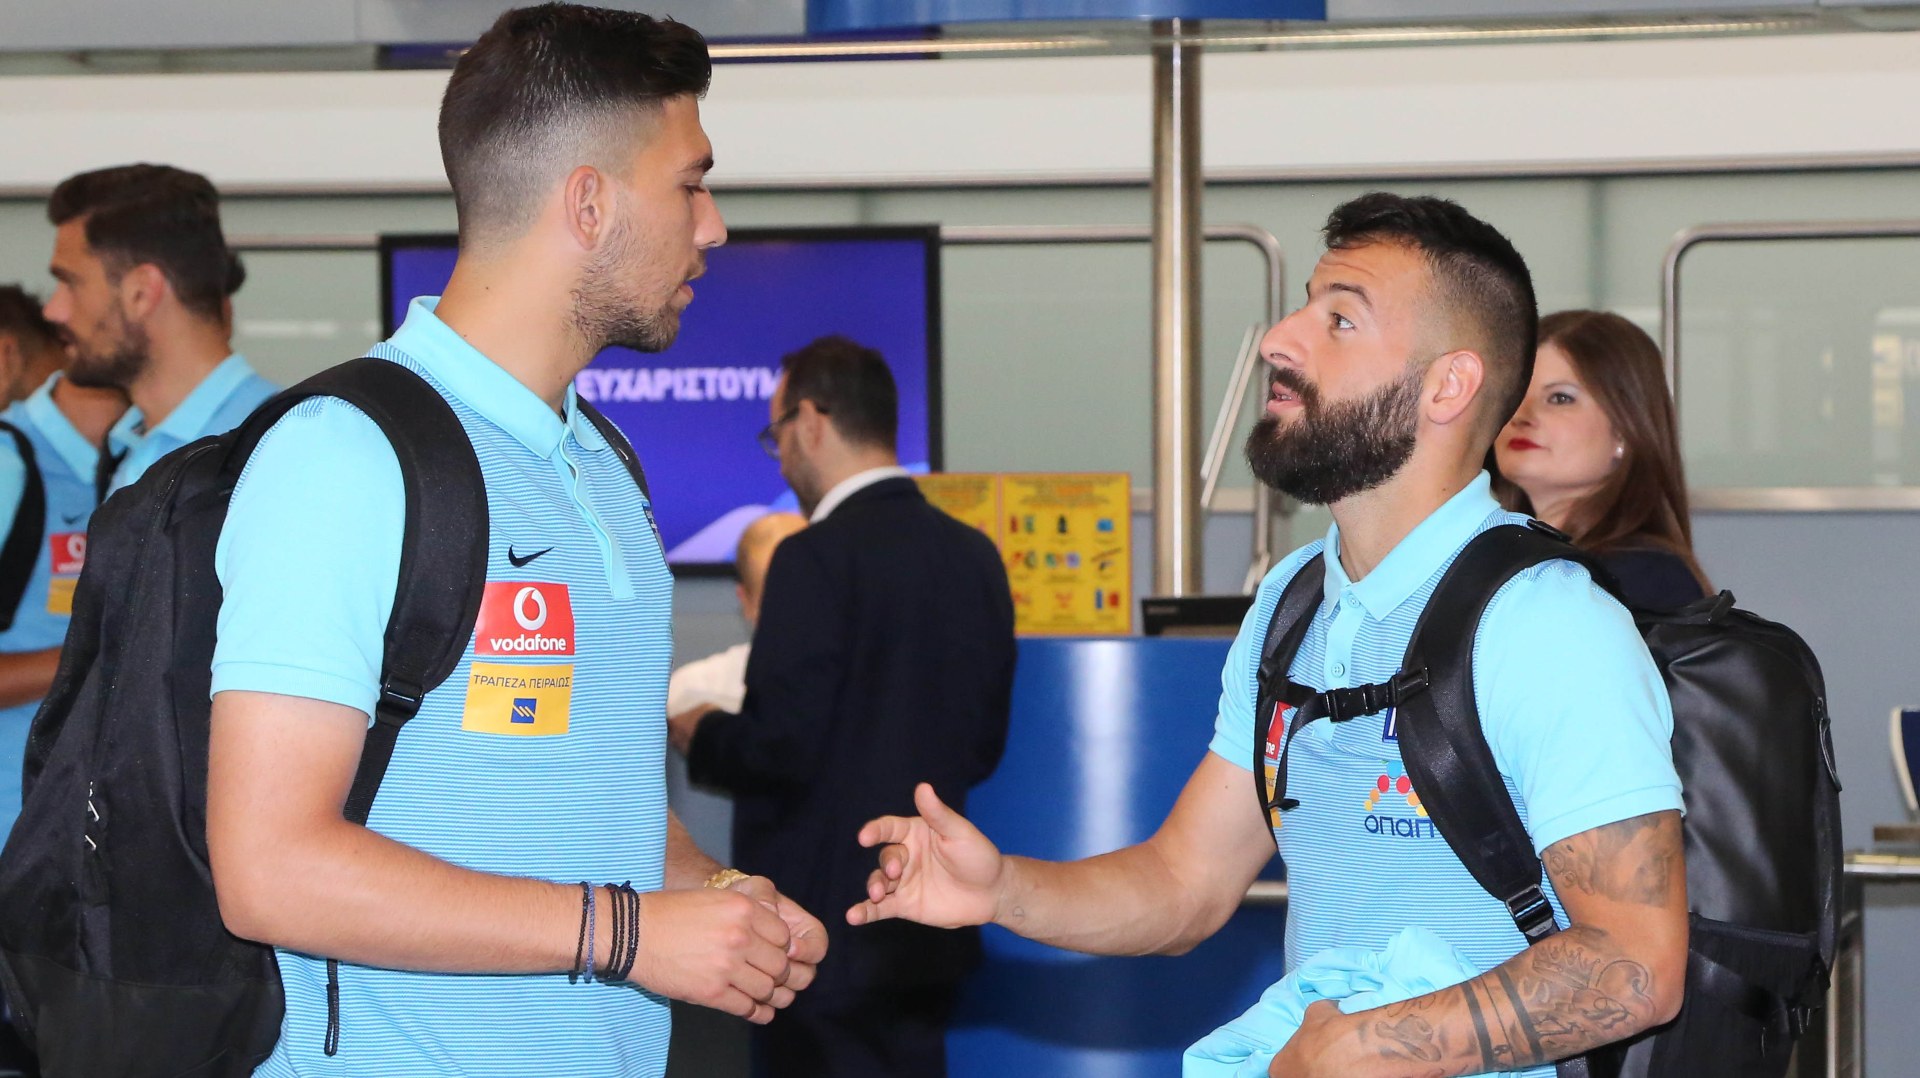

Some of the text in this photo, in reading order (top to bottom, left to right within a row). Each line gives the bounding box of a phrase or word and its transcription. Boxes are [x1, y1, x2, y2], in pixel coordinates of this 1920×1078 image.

[490, 634, 566, 651] vodafone
[473, 674, 571, 689] ΤΡΑΠΕΖΑ ΠΕΙΡΑΙΩΣ
